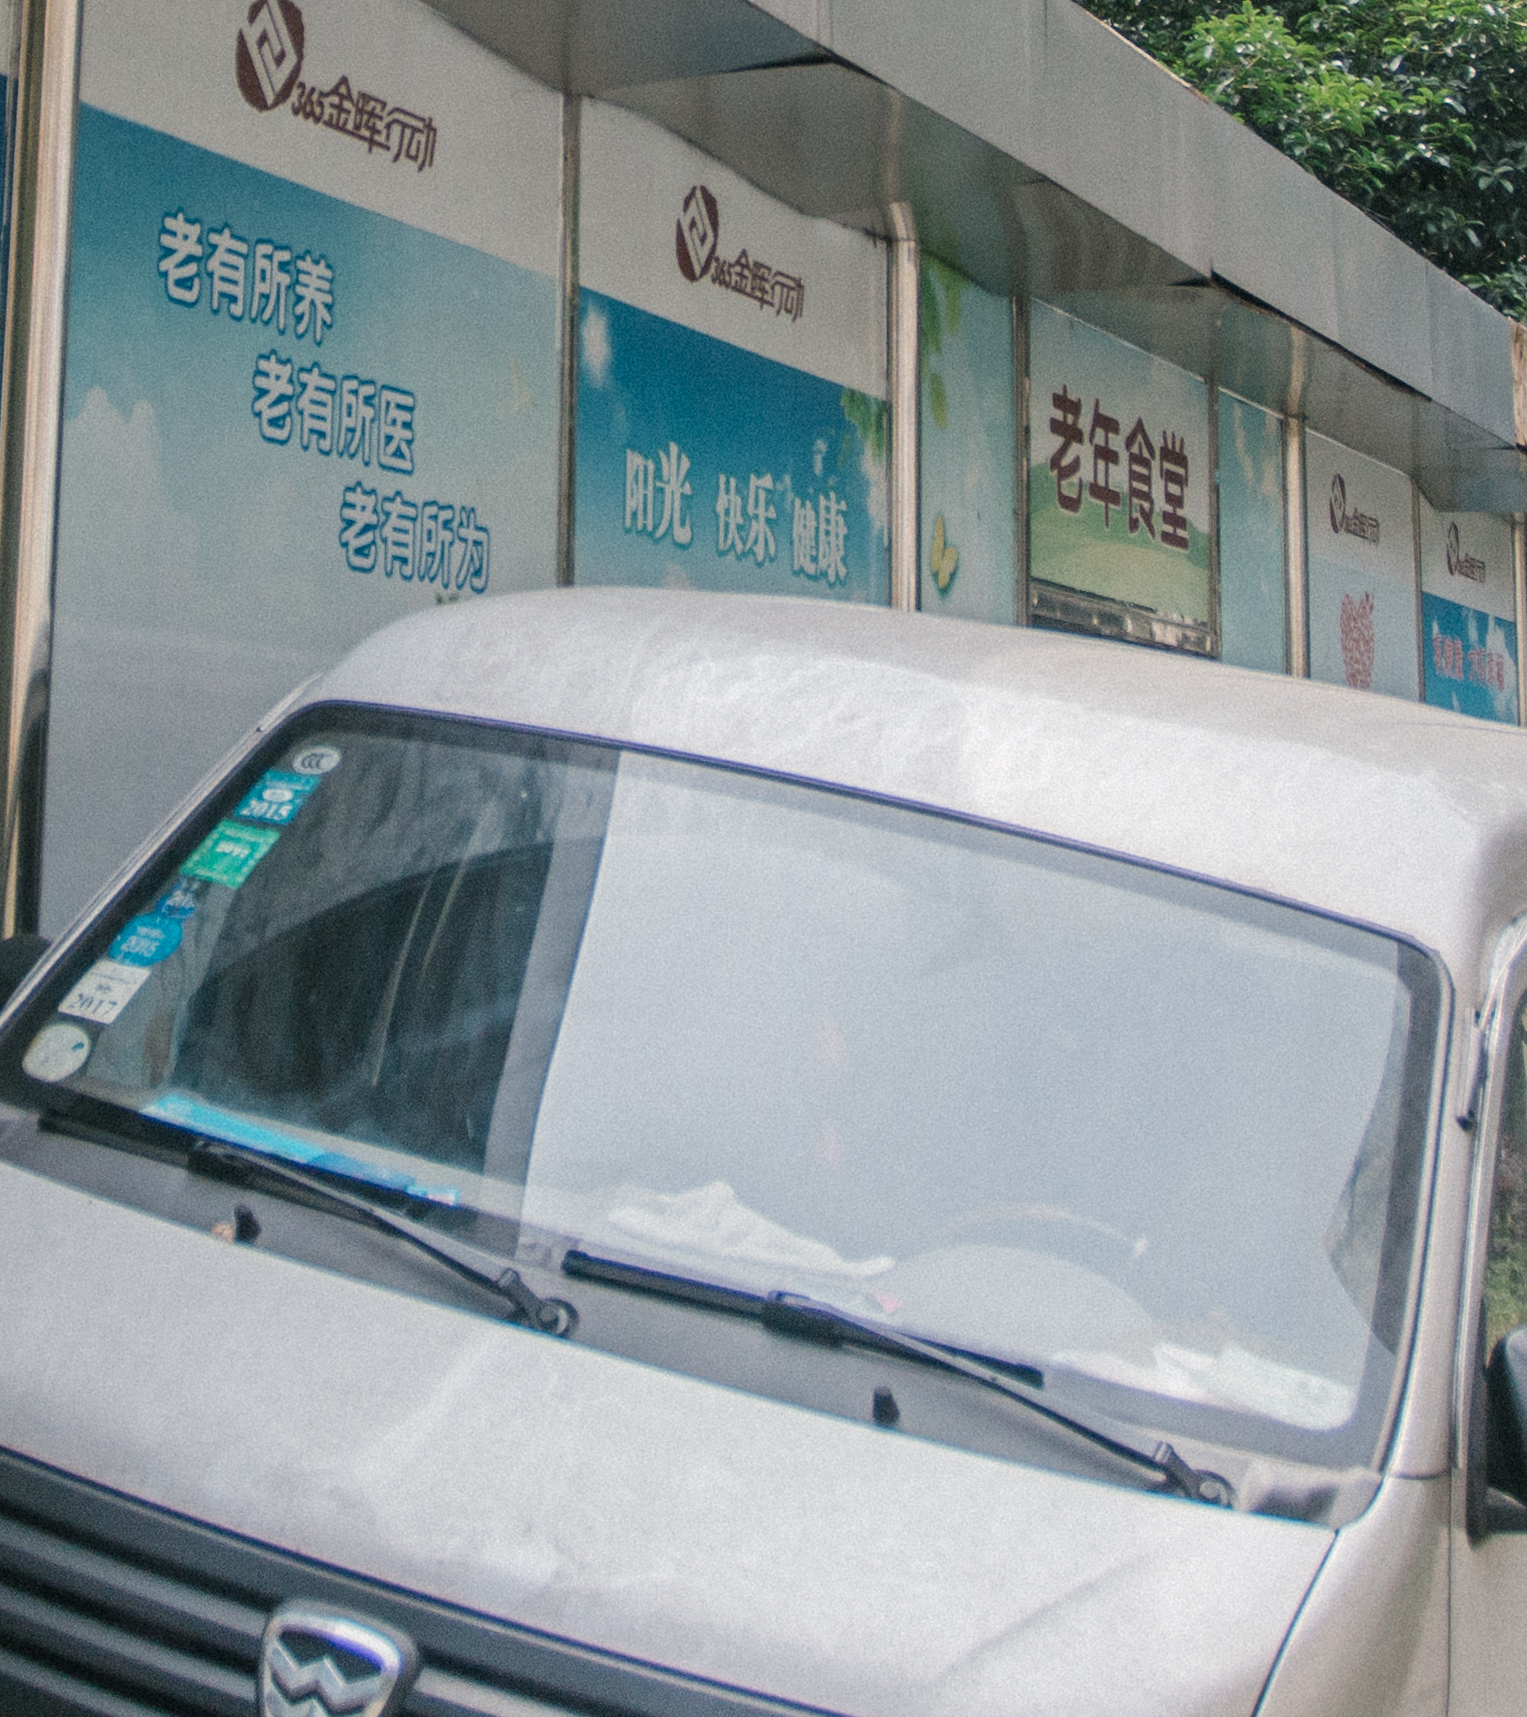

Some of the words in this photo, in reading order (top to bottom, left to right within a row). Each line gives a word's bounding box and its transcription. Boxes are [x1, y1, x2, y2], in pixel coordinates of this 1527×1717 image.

[159, 212, 335, 345] 老有所养
[252, 349, 417, 476] 老有所医
[1048, 385, 1190, 551] 老年食堂
[338, 481, 491, 593] 老有所为
[625, 441, 693, 545] 阳光
[716, 472, 777, 565] 快乐
[792, 490, 848, 584] 健康
[239, 797, 293, 821] 2015
[67, 992, 118, 1017] 2017
